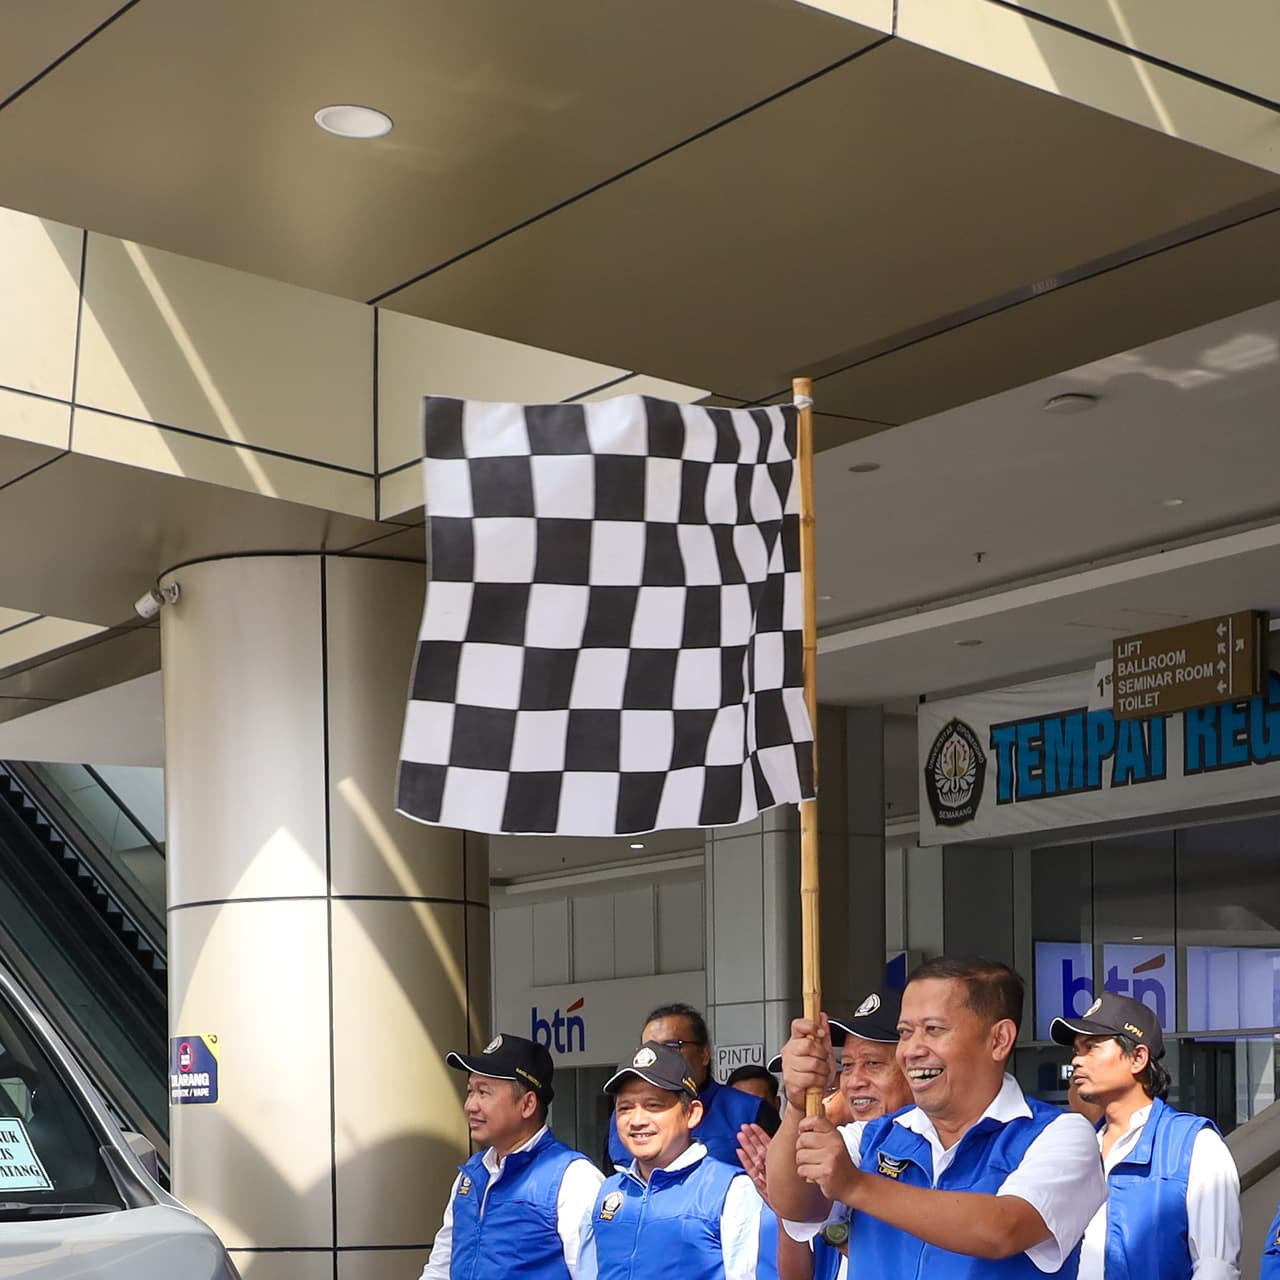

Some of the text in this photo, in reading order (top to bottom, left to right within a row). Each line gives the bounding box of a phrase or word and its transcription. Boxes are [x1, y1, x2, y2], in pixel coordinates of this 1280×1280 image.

[1118, 640, 1142, 658] LIFT
[1118, 650, 1186, 677] BALLROOM
[1118, 662, 1214, 695] SEMINAR ROOM
[1119, 692, 1160, 713] TOILET
[989, 706, 1170, 806] TEMPAT
[531, 999, 585, 1054] btn
[1124, 1022, 1144, 1038] LPPM
[719, 1047, 762, 1065] PINTU
